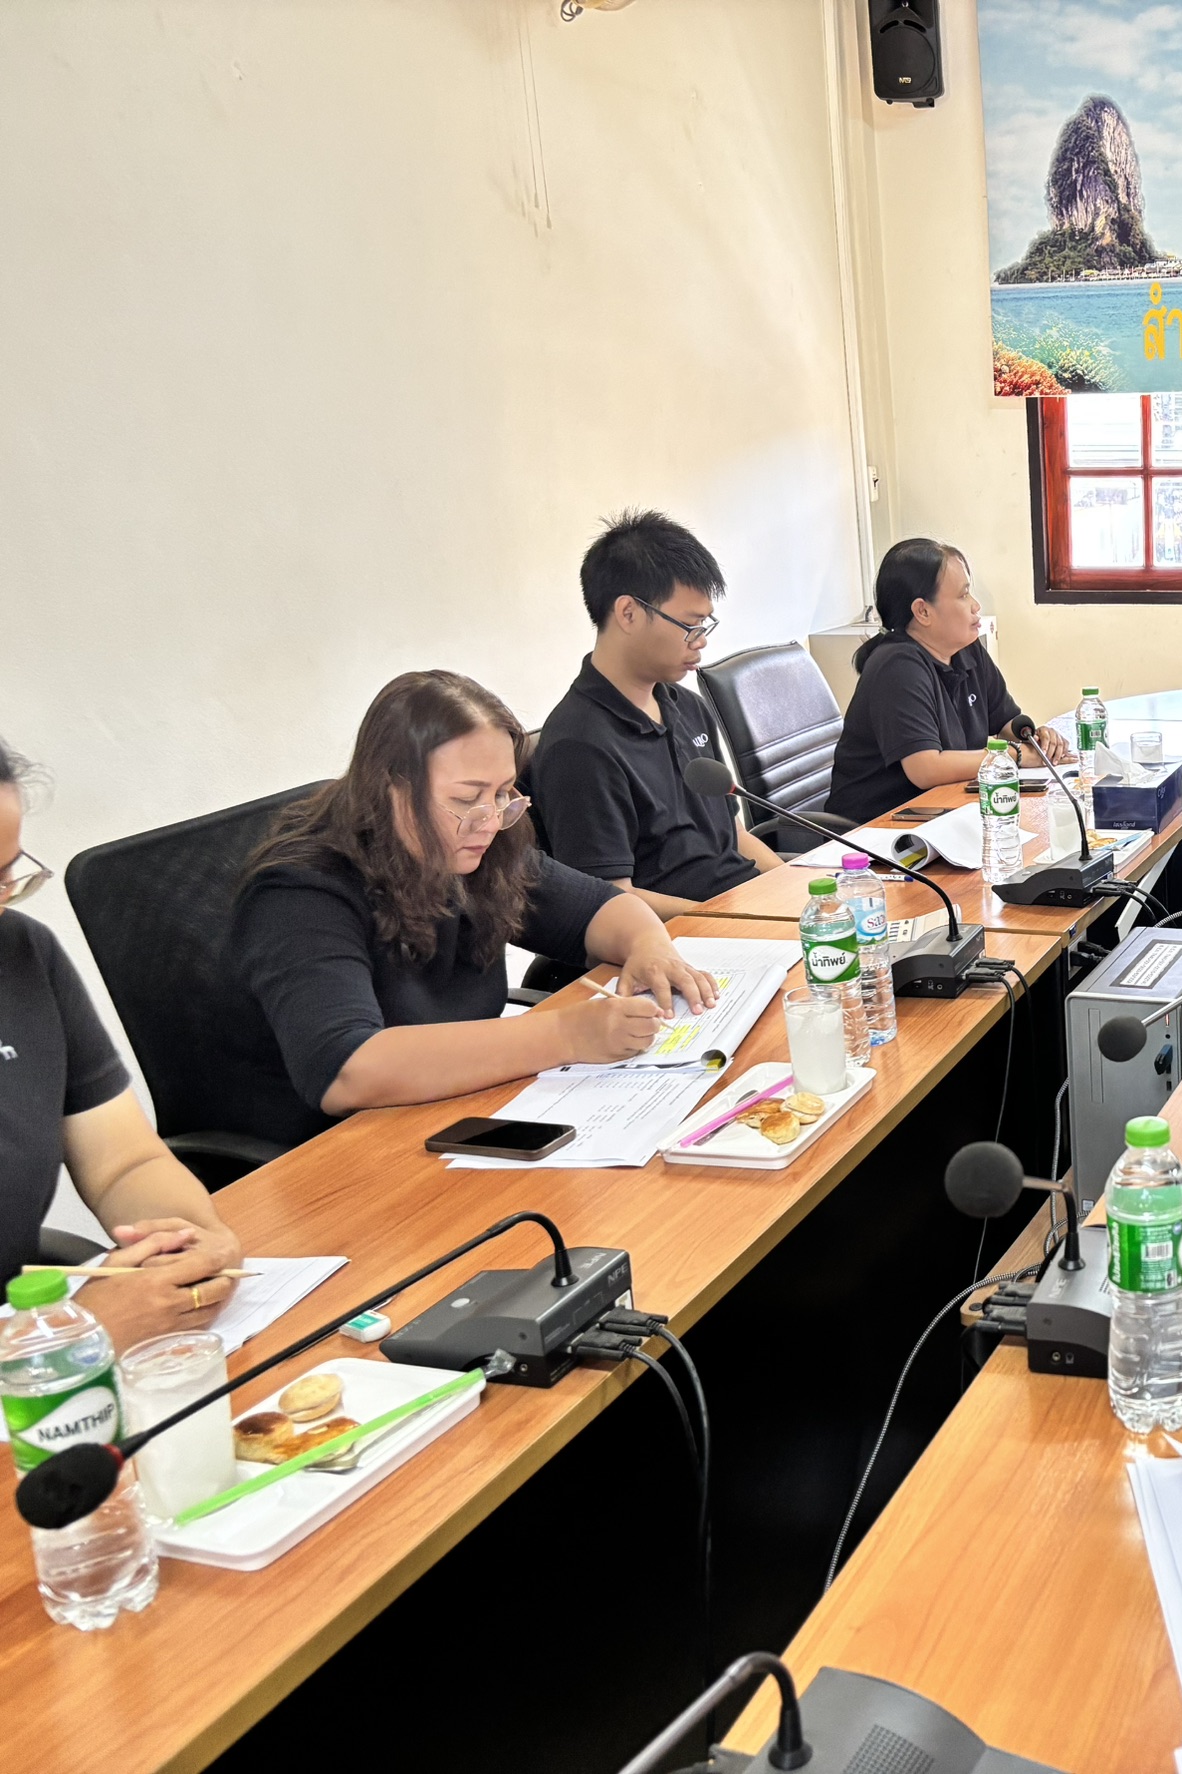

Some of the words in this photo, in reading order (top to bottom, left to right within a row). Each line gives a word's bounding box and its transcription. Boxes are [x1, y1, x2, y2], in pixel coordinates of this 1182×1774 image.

[811, 951, 847, 968] น้ำทิพย์
[38, 1402, 115, 1442] NAMTHIP
